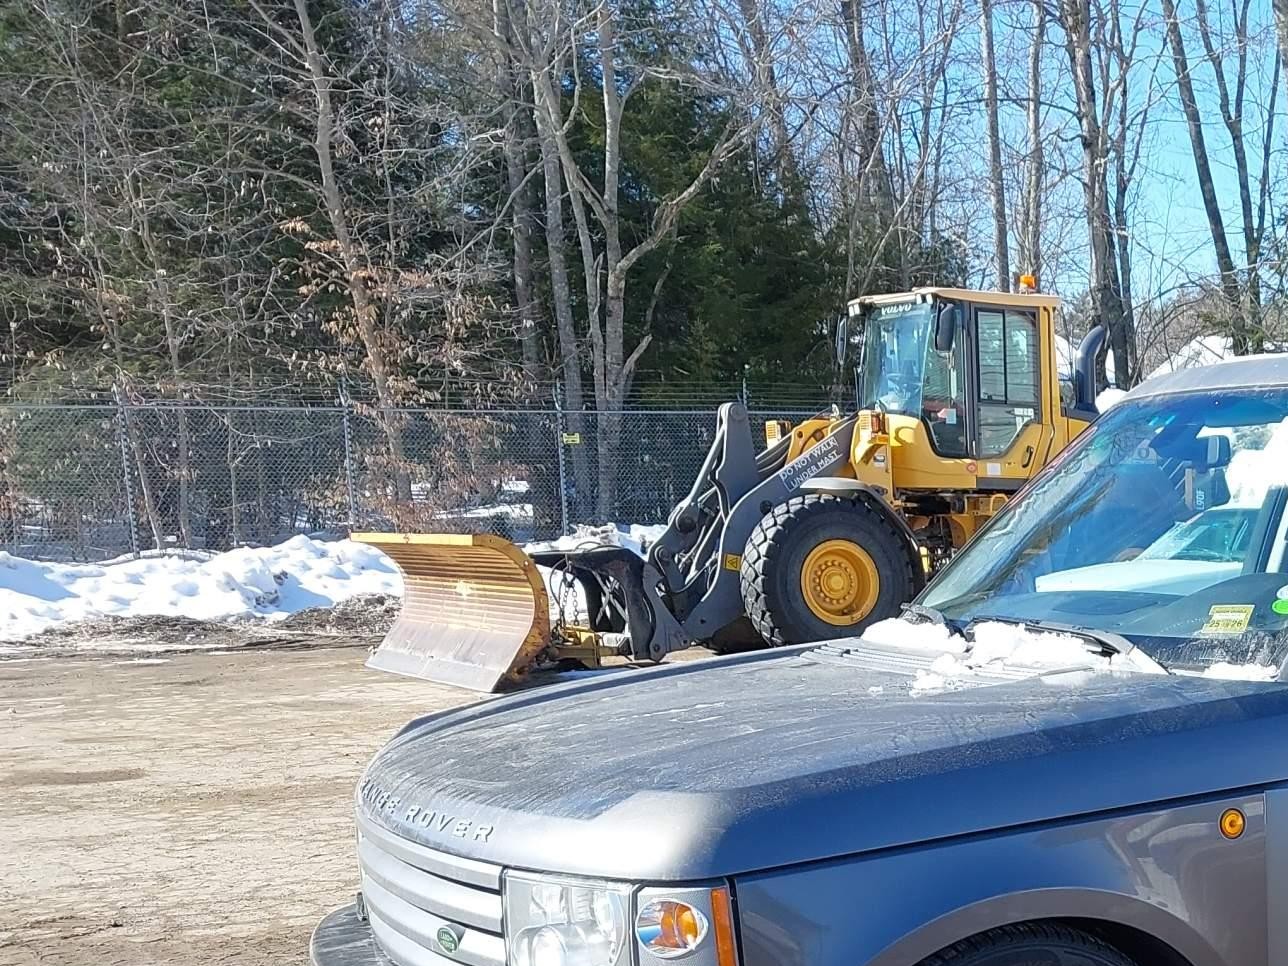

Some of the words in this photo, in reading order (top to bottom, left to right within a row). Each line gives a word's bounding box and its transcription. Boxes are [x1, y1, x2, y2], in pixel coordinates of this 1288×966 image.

[881, 303, 912, 316] VOLVO
[779, 466, 794, 481] DO
[794, 453, 812, 471] NOT
[812, 436, 838, 458] WALK
[790, 465, 818, 488] UNDER
[818, 449, 839, 469] MAST
[404, 805, 496, 843] ROVER
